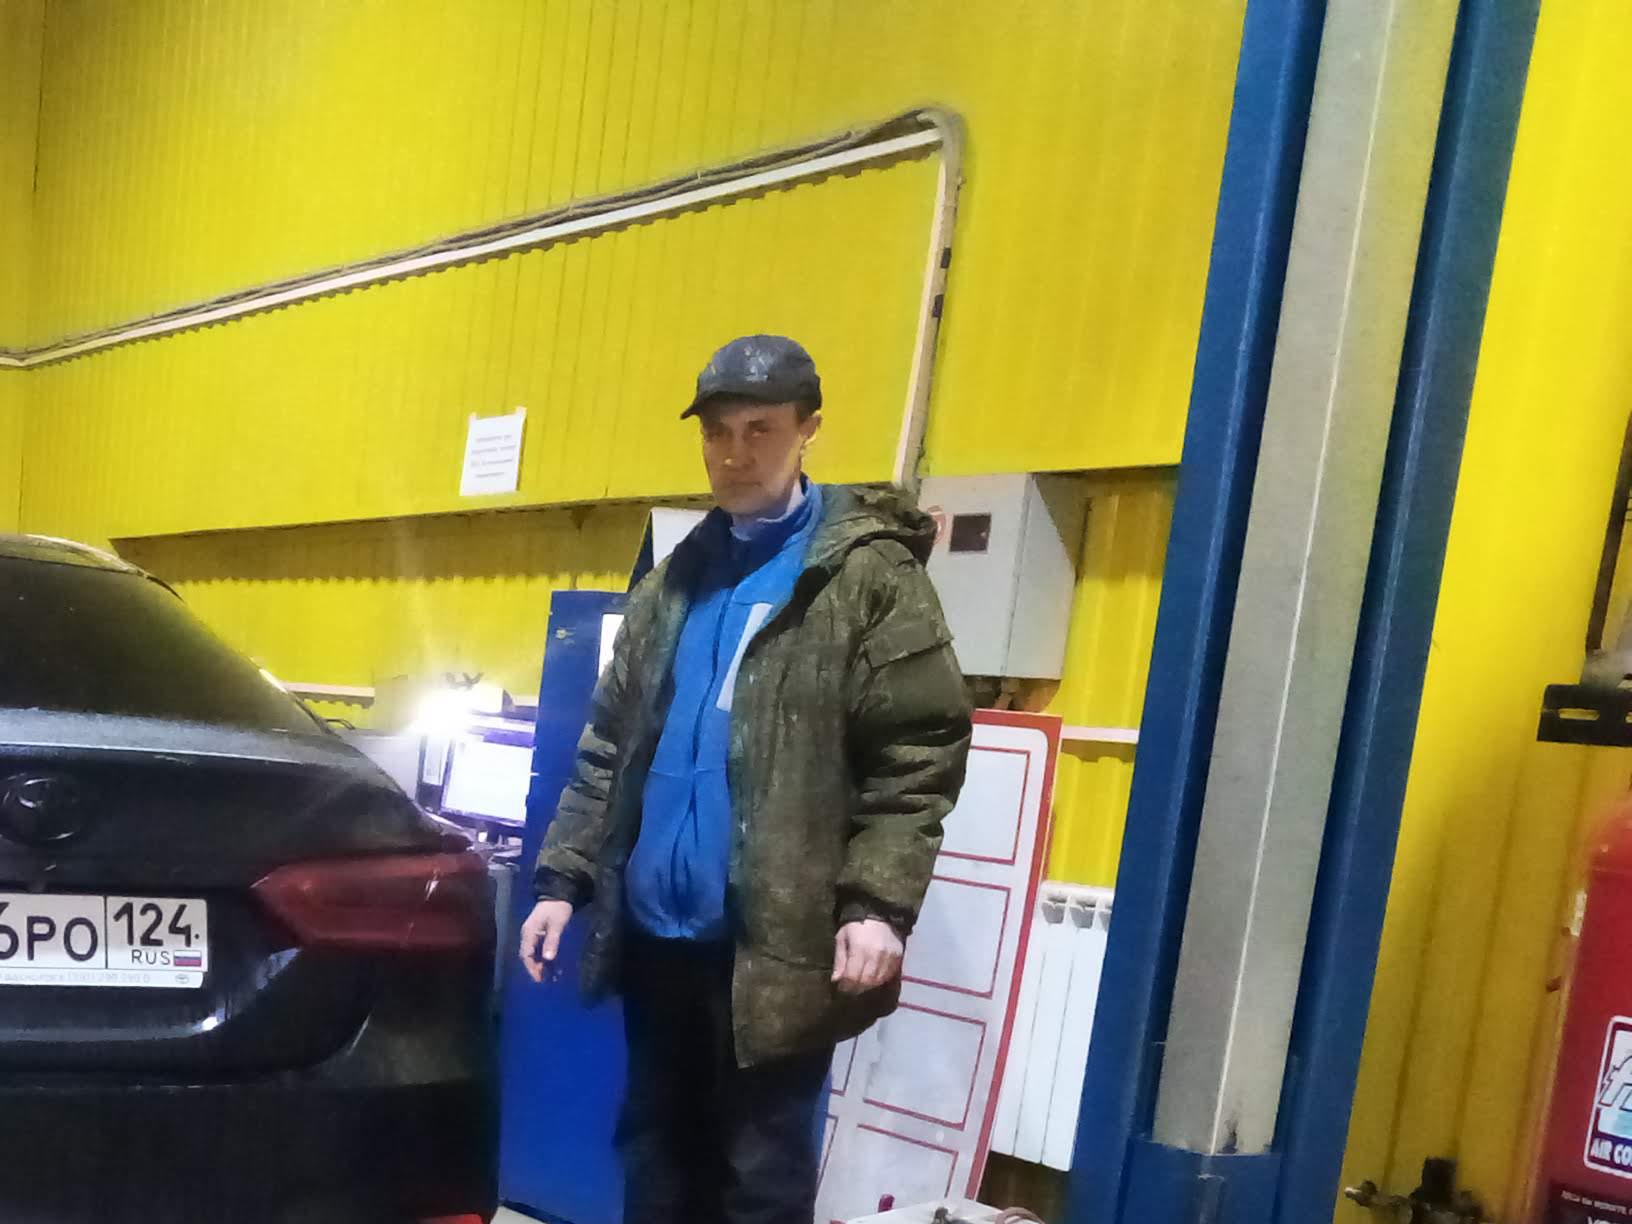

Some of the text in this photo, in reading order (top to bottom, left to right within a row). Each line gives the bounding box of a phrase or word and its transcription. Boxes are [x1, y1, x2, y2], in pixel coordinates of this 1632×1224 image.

[113, 901, 192, 948] 124
[131, 949, 171, 966] RUS
[1614, 1144, 1632, 1167] CO
